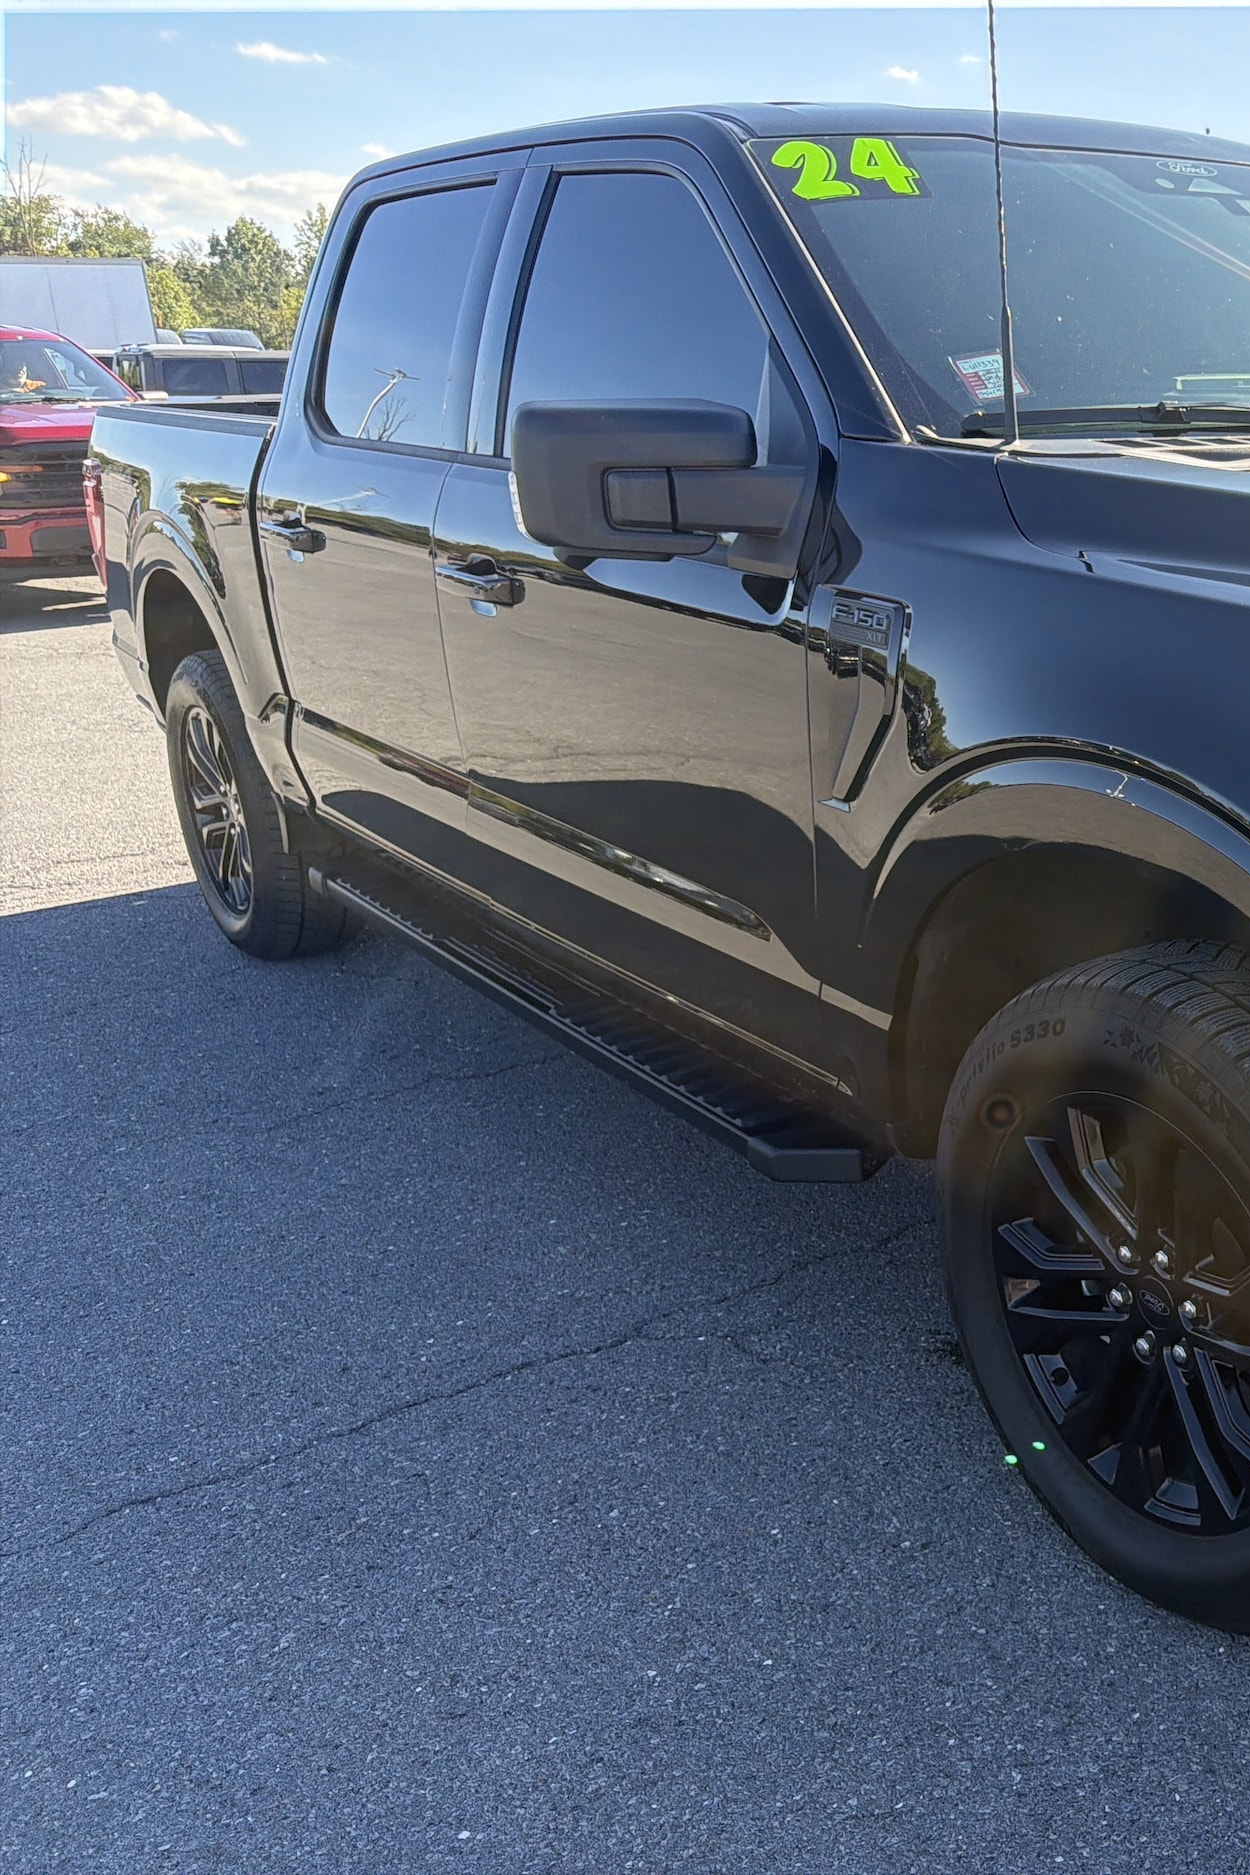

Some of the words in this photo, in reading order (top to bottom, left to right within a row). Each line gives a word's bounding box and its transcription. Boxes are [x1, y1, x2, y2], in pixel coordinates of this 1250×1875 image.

[771, 137, 920, 200] 24
[832, 605, 887, 630] F-150
[867, 632, 886, 644] XLT
[1010, 1018, 1066, 1049] S330
